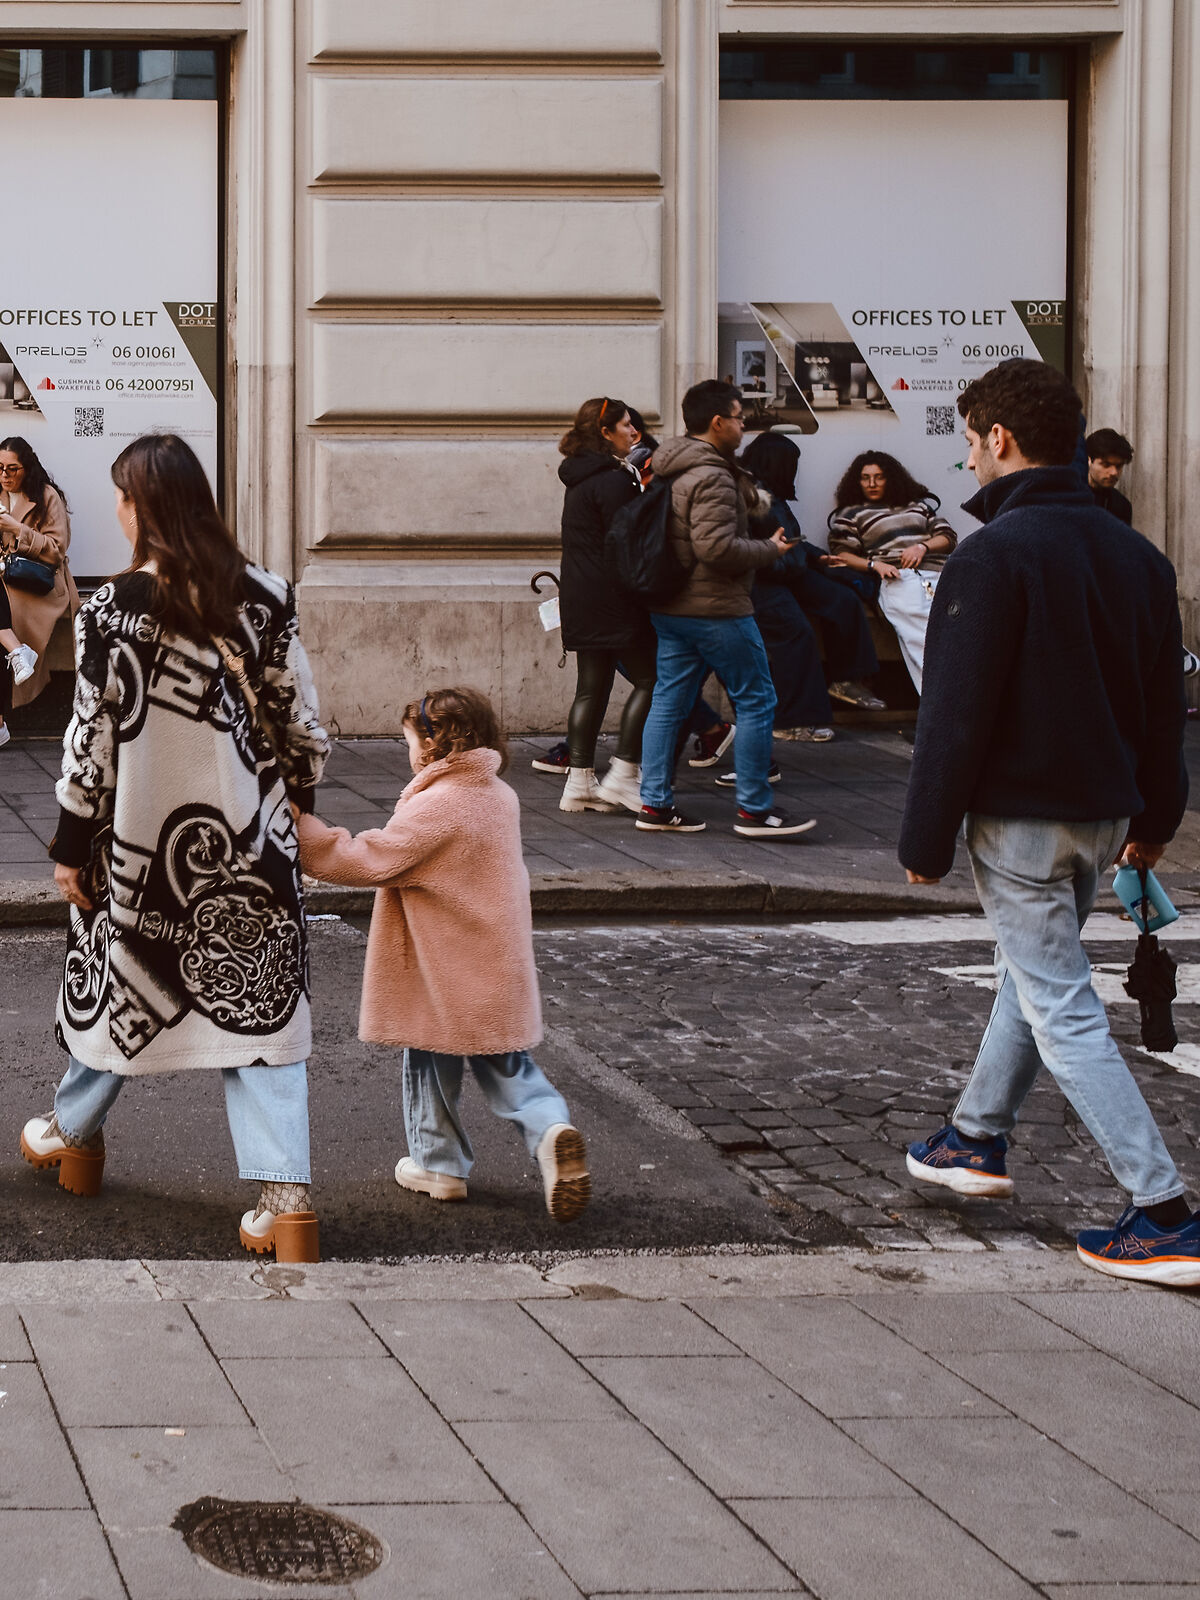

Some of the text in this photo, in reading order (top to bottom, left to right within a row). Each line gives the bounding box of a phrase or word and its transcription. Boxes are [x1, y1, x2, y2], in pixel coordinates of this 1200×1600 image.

[178, 303, 214, 318] DOT
[1026, 302, 1062, 316] DOT
[87, 310, 117, 327] TO
[122, 311, 159, 327] LET
[852, 309, 1007, 326] OFFICES TO LET
[16, 346, 88, 356] PRELIOS
[112, 345, 176, 359] 06 01061
[869, 346, 938, 356] PRELIOS
[962, 344, 1025, 357] 06 01061
[105, 378, 194, 391] 06 42007951
